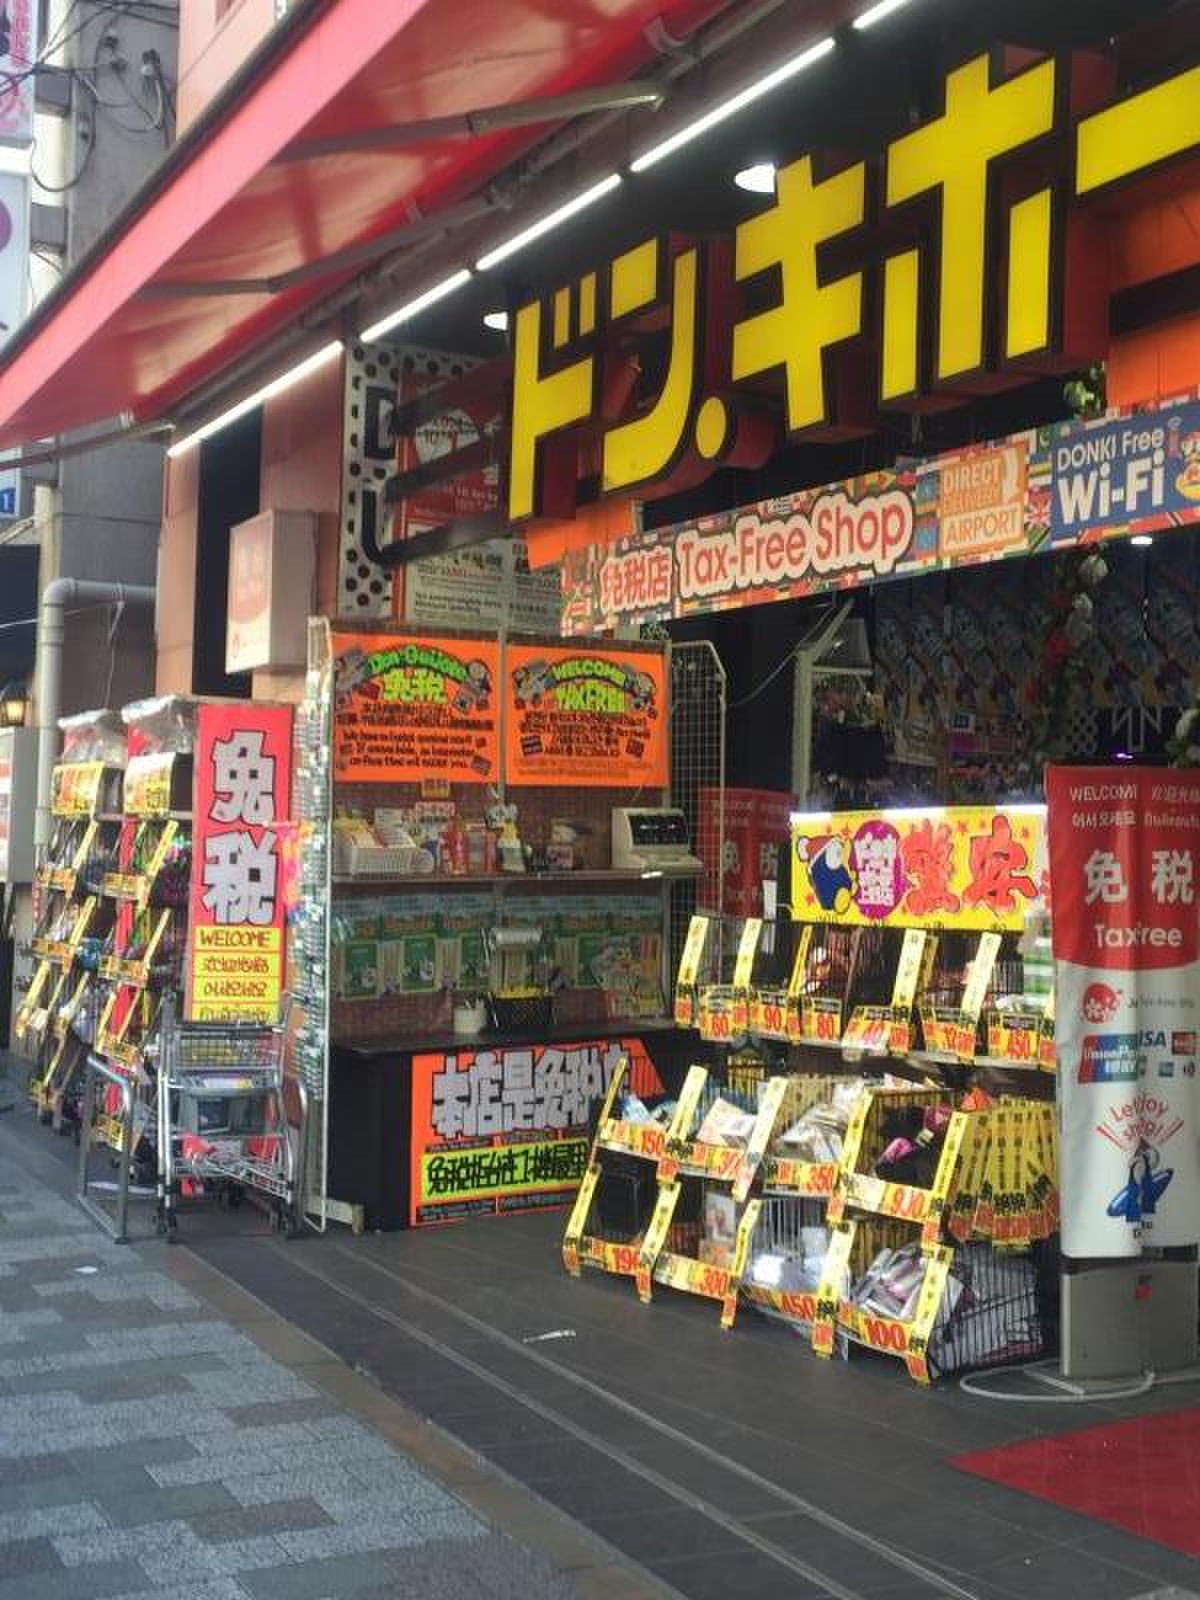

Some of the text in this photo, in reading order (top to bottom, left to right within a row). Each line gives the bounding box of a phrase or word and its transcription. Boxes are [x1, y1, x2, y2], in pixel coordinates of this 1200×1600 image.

[1057, 427, 1165, 472] DONKI Free
[943, 457, 1003, 495] DIRECT
[1057, 450, 1165, 525] Wi-Fi
[680, 522, 807, 586] Tax-Free
[816, 502, 907, 560] Shop
[946, 510, 1017, 546] AIRPORT
[1084, 849, 1194, 904] 免税
[200, 930, 271, 947] WELCOME
